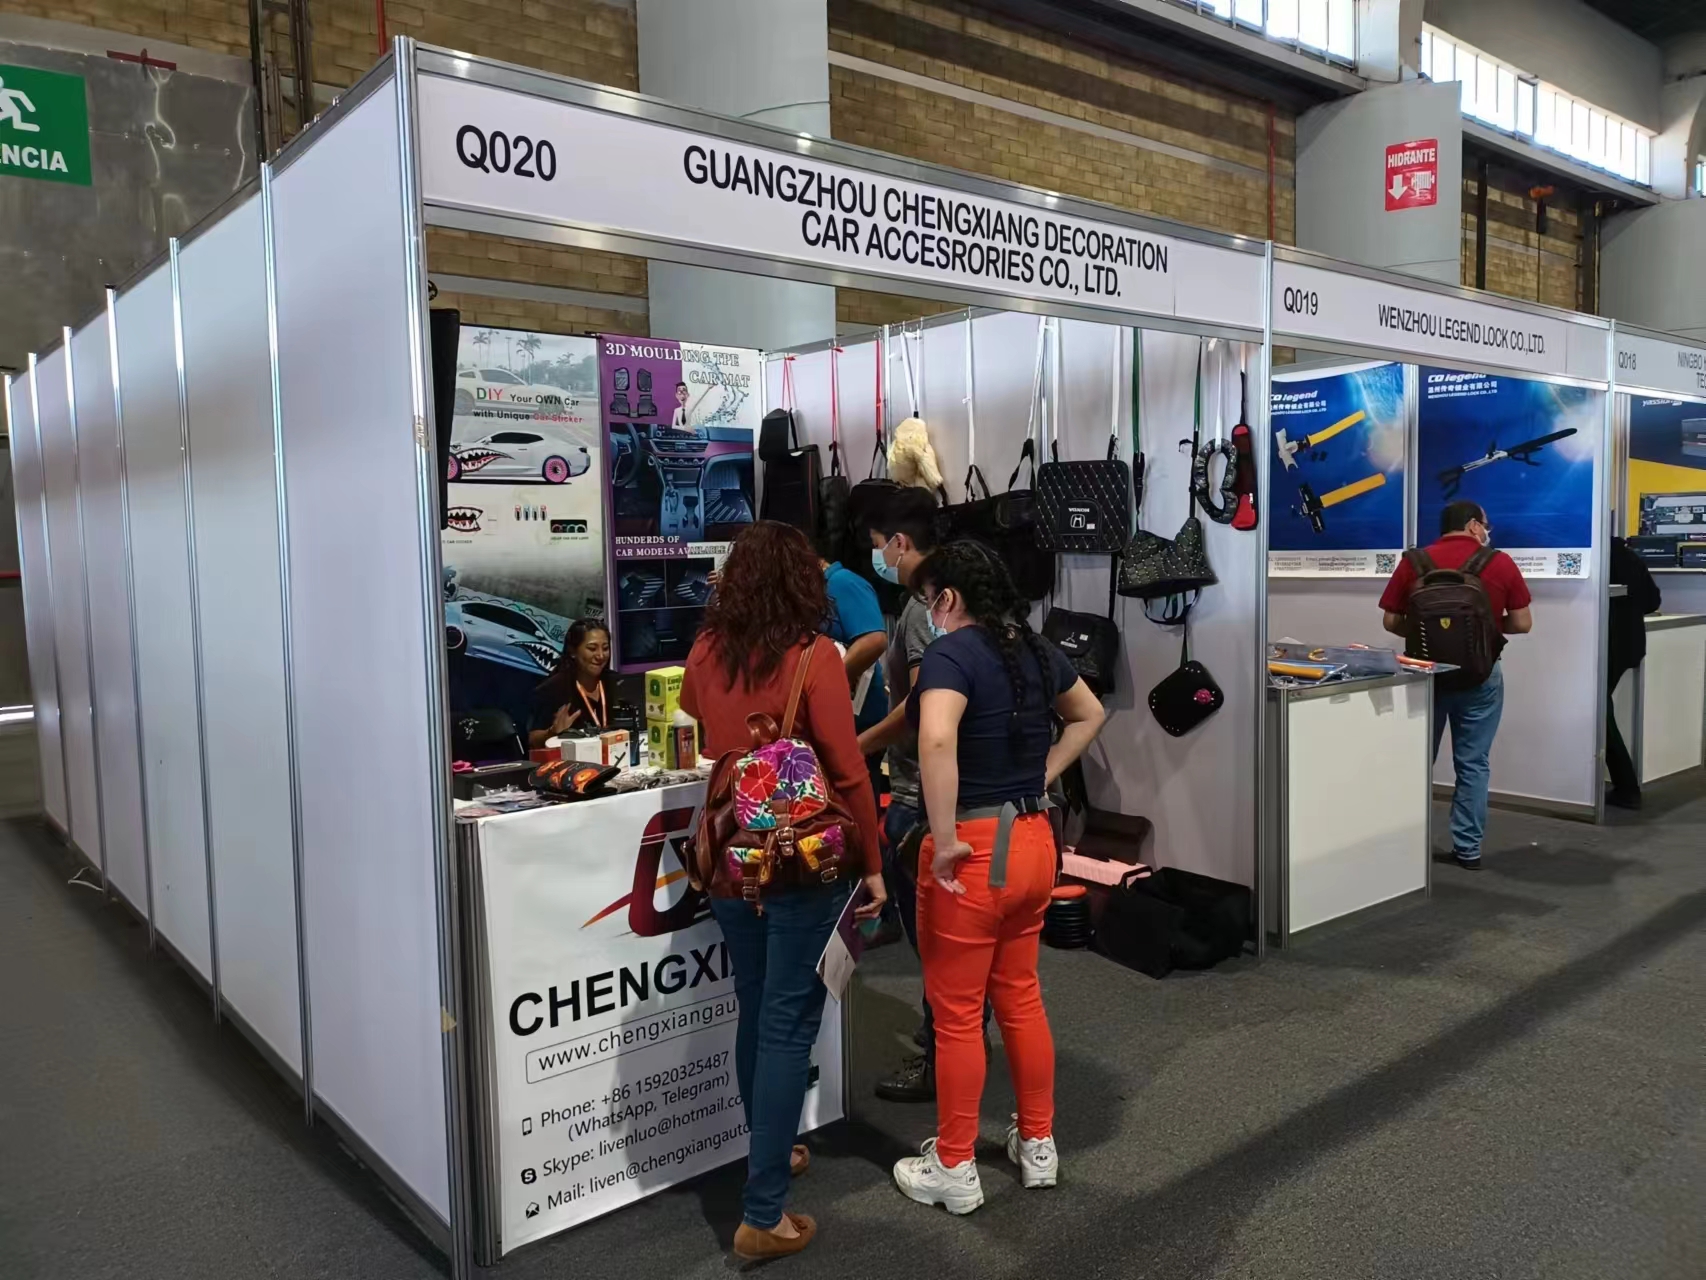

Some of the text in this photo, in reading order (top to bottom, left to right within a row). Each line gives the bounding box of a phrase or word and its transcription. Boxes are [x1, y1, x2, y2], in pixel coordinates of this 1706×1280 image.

[0, 143, 68, 173] NCIA
[456, 125, 556, 181] Q020
[1387, 148, 1436, 169] HIDRANTE
[684, 145, 1168, 273] GUANGZHOU CHENGXIANG DECORATION
[802, 210, 1122, 297] CAR ACCESRORIES CO., LTD.
[1283, 286, 1318, 316] Q019
[1378, 303, 1437, 337] WENZHOU
[1439, 317, 1480, 344] LEGEND
[1483, 325, 1508, 349] LOCK
[606, 342, 740, 367] 3D MOULDING TPE
[1618, 352, 1636, 370] Q018
[1677, 352, 1702, 370] NINGBO
[689, 371, 751, 388] CAR MAT
[476, 387, 579, 406] DIY Your OWN Car
[1282, 390, 1318, 402] legend
[473, 409, 493, 418] with
[497, 410, 530, 421] Unique
[551, 414, 583, 423] Sticker
[615, 535, 680, 545] HUNDERDS OF
[616, 548, 633, 557] CAR
[636, 547, 674, 556] MODELS
[509, 941, 736, 1037] CHENGXI
[539, 999, 736, 1070] www.chengxiangau
[540, 1051, 730, 1127] Phone: +86 15920325487
[568, 1071, 730, 1142] (WhatsApp, Telegram)
[542, 1094, 744, 1177] Skype: livenluo@hotmail.co
[547, 1123, 750, 1210] Mail: liven@chengxiangauto
